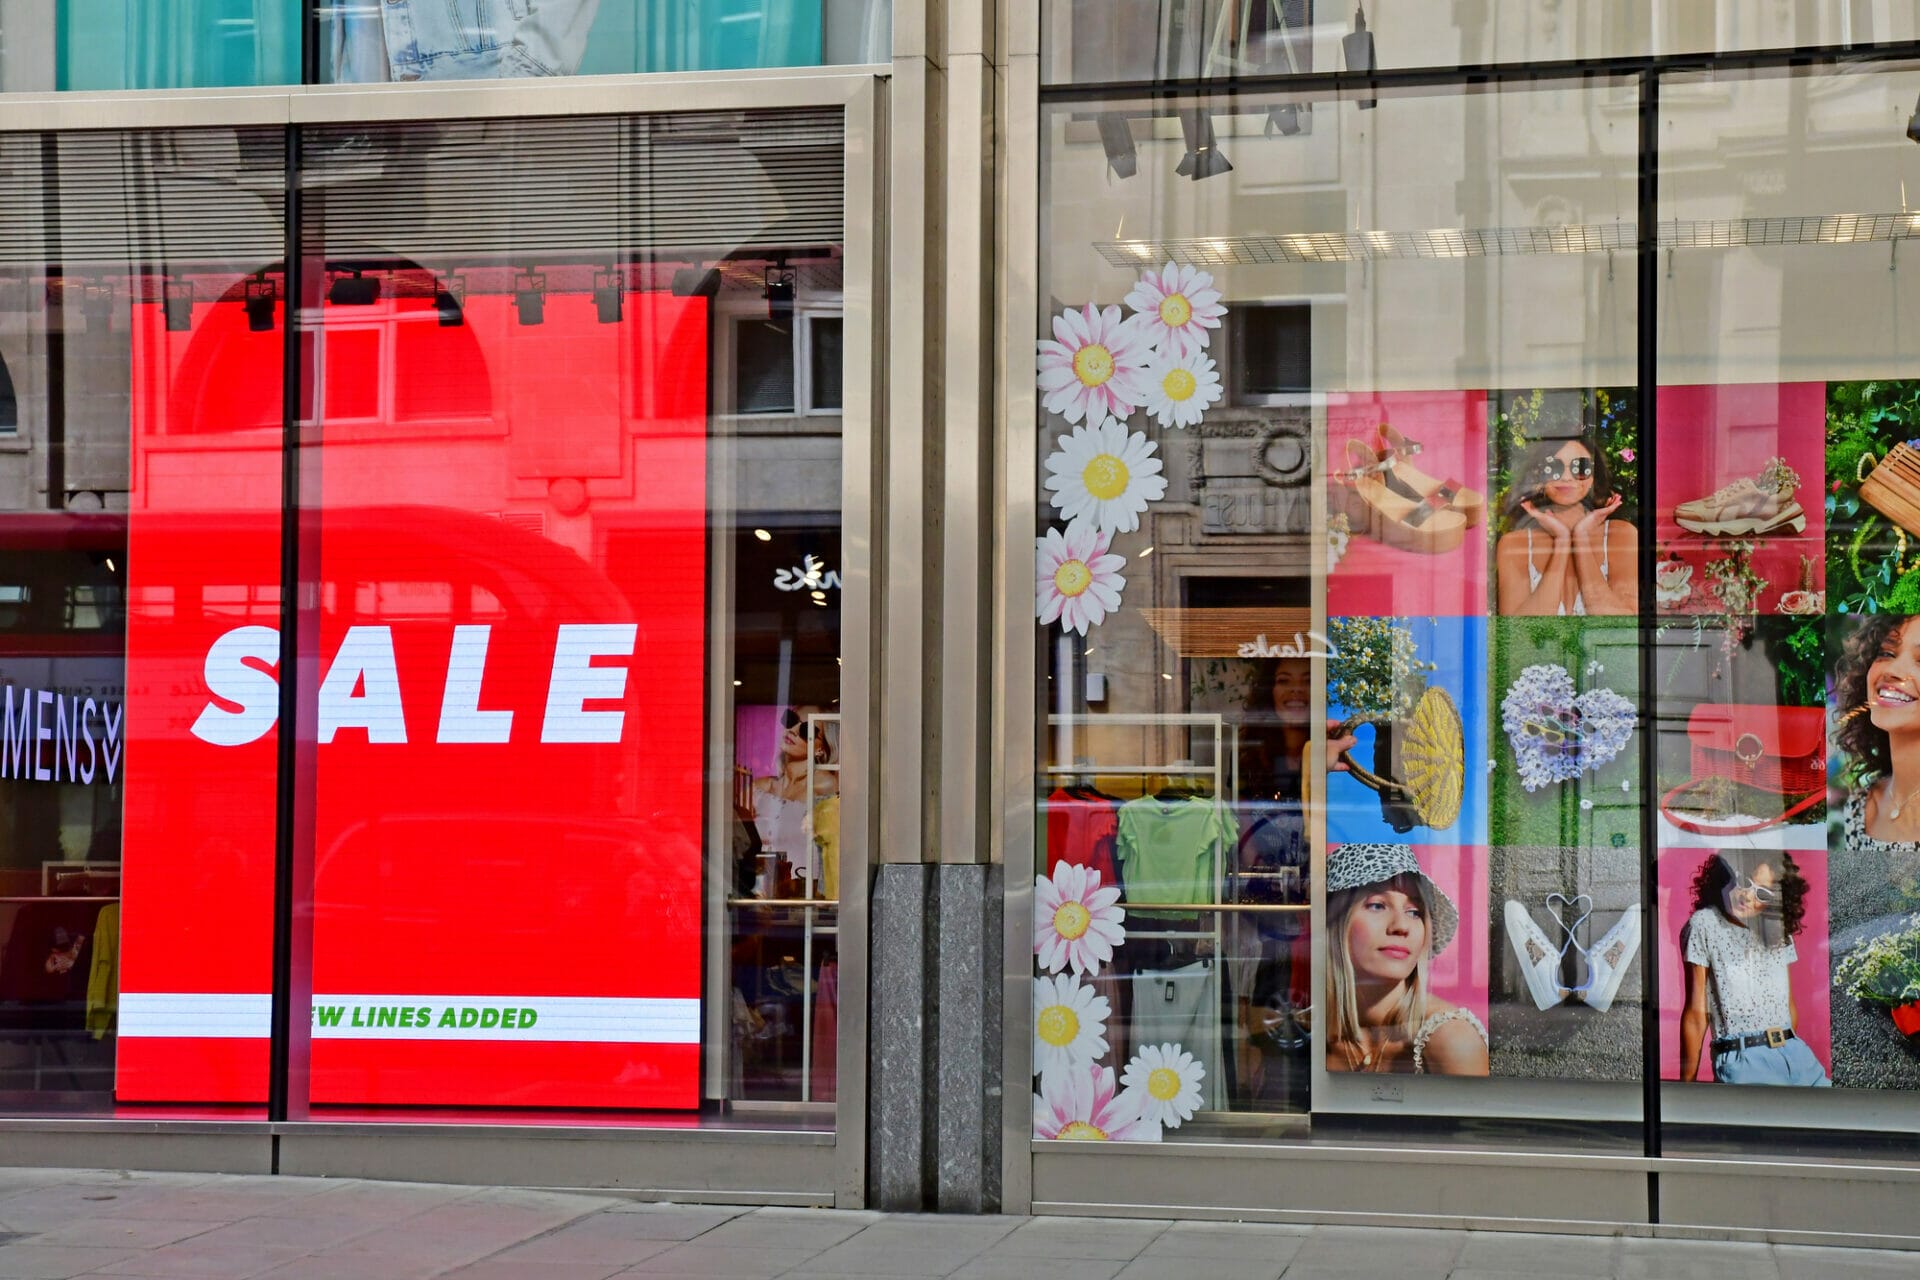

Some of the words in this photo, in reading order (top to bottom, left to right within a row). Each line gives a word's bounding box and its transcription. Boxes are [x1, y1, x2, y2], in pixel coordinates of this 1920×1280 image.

[190, 623, 638, 746] SALE
[2, 685, 96, 784] MENS
[351, 1006, 432, 1028] LINES
[437, 1007, 538, 1029] ADDED
